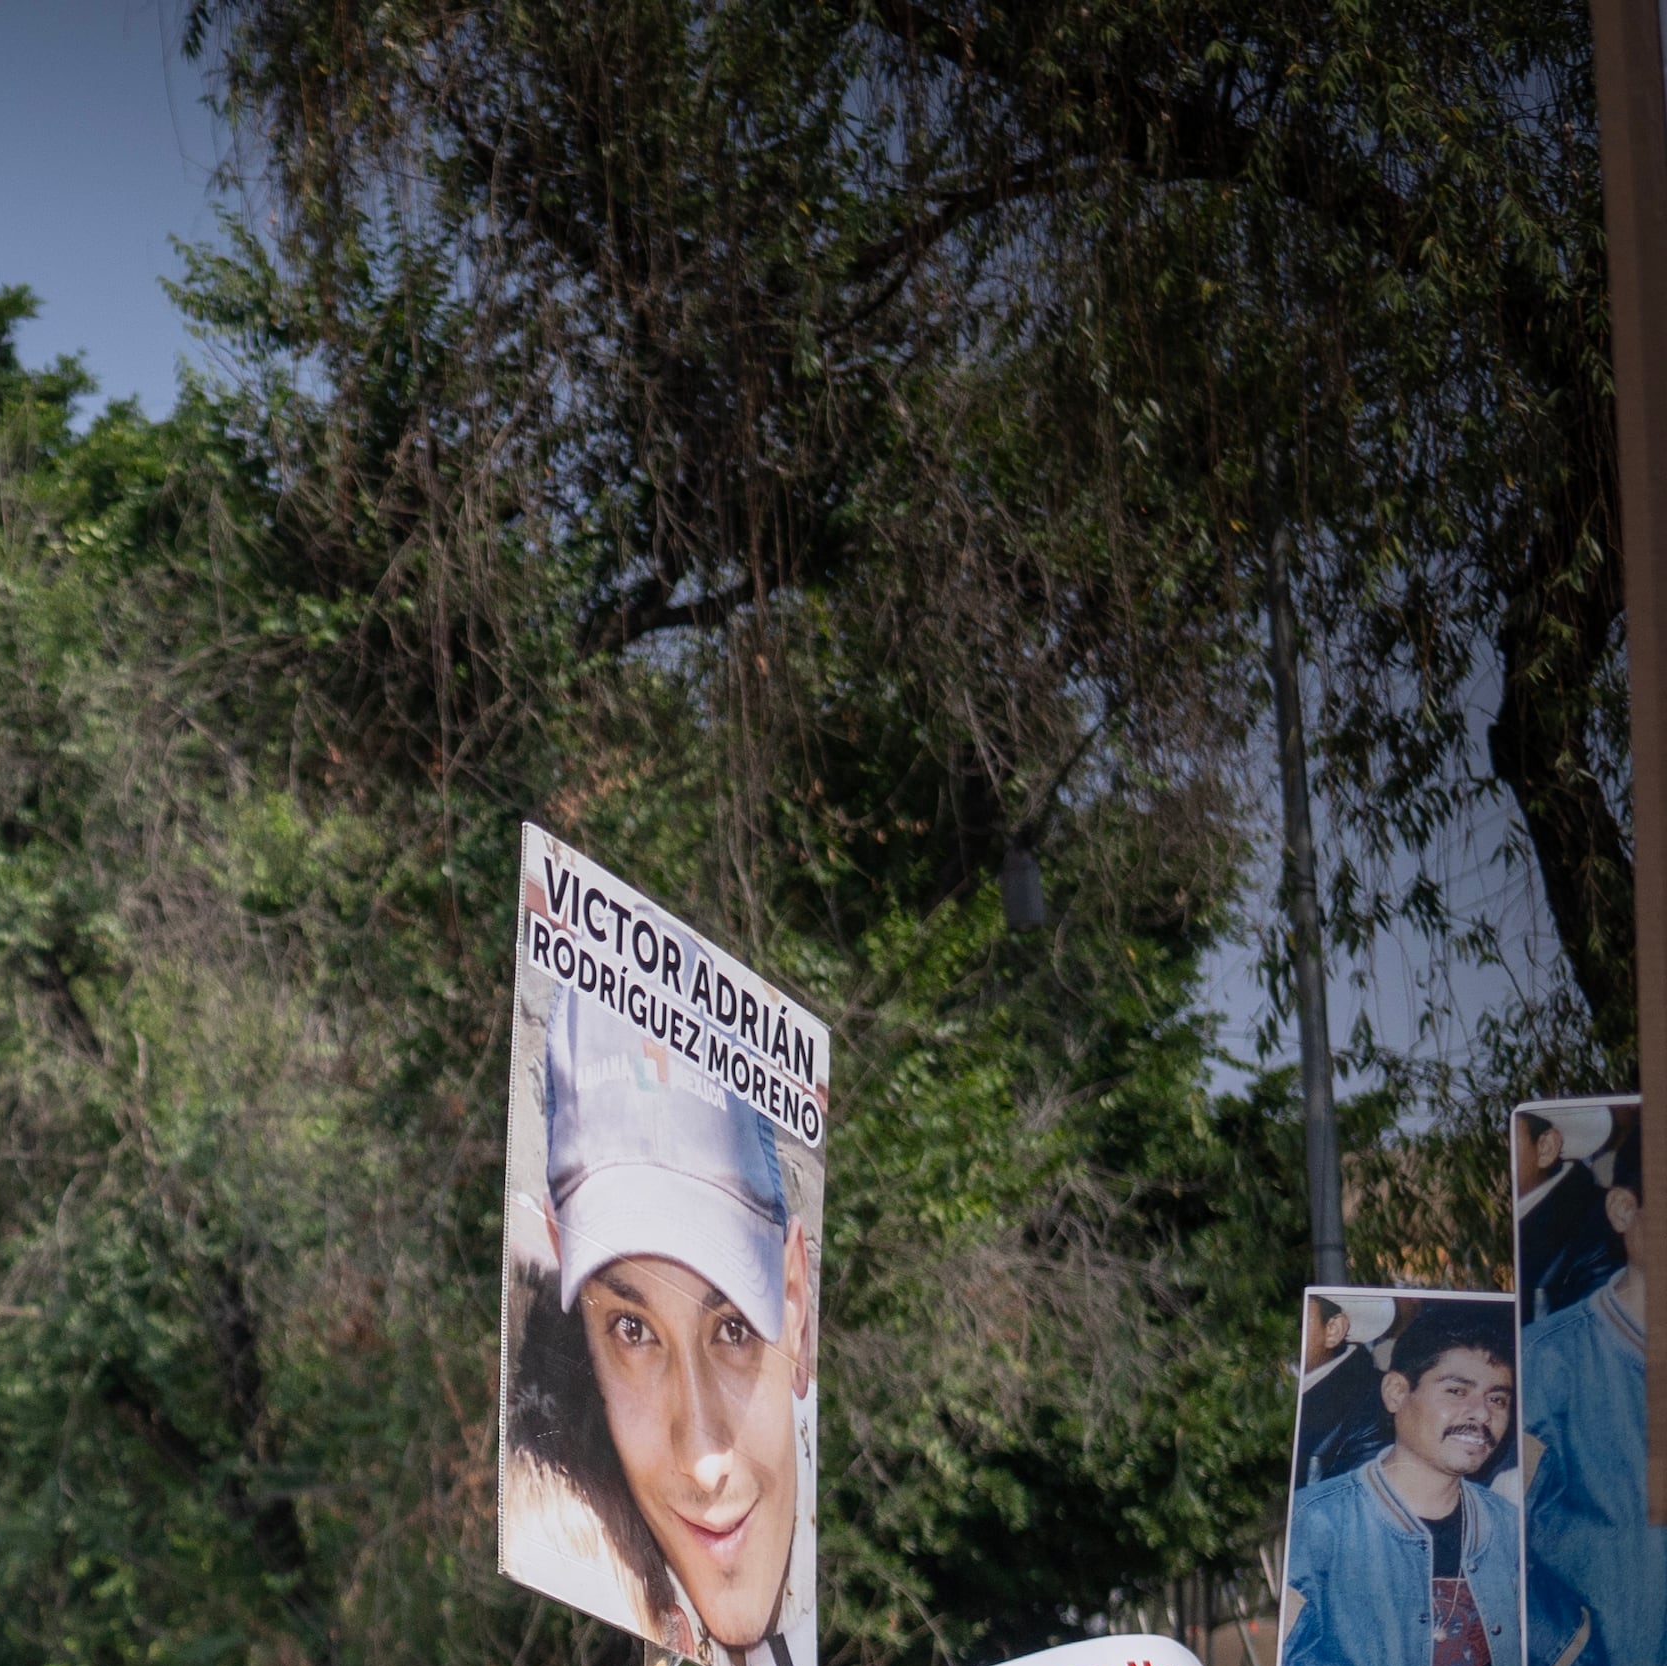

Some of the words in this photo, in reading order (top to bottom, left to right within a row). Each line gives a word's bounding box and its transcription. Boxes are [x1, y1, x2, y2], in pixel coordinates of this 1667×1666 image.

[533, 921, 701, 1063] RODRÍGUEZ
[708, 1035, 819, 1142] MORENO
[544, 855, 683, 995] VICTOR
[690, 960, 815, 1086] ADRIÁN
